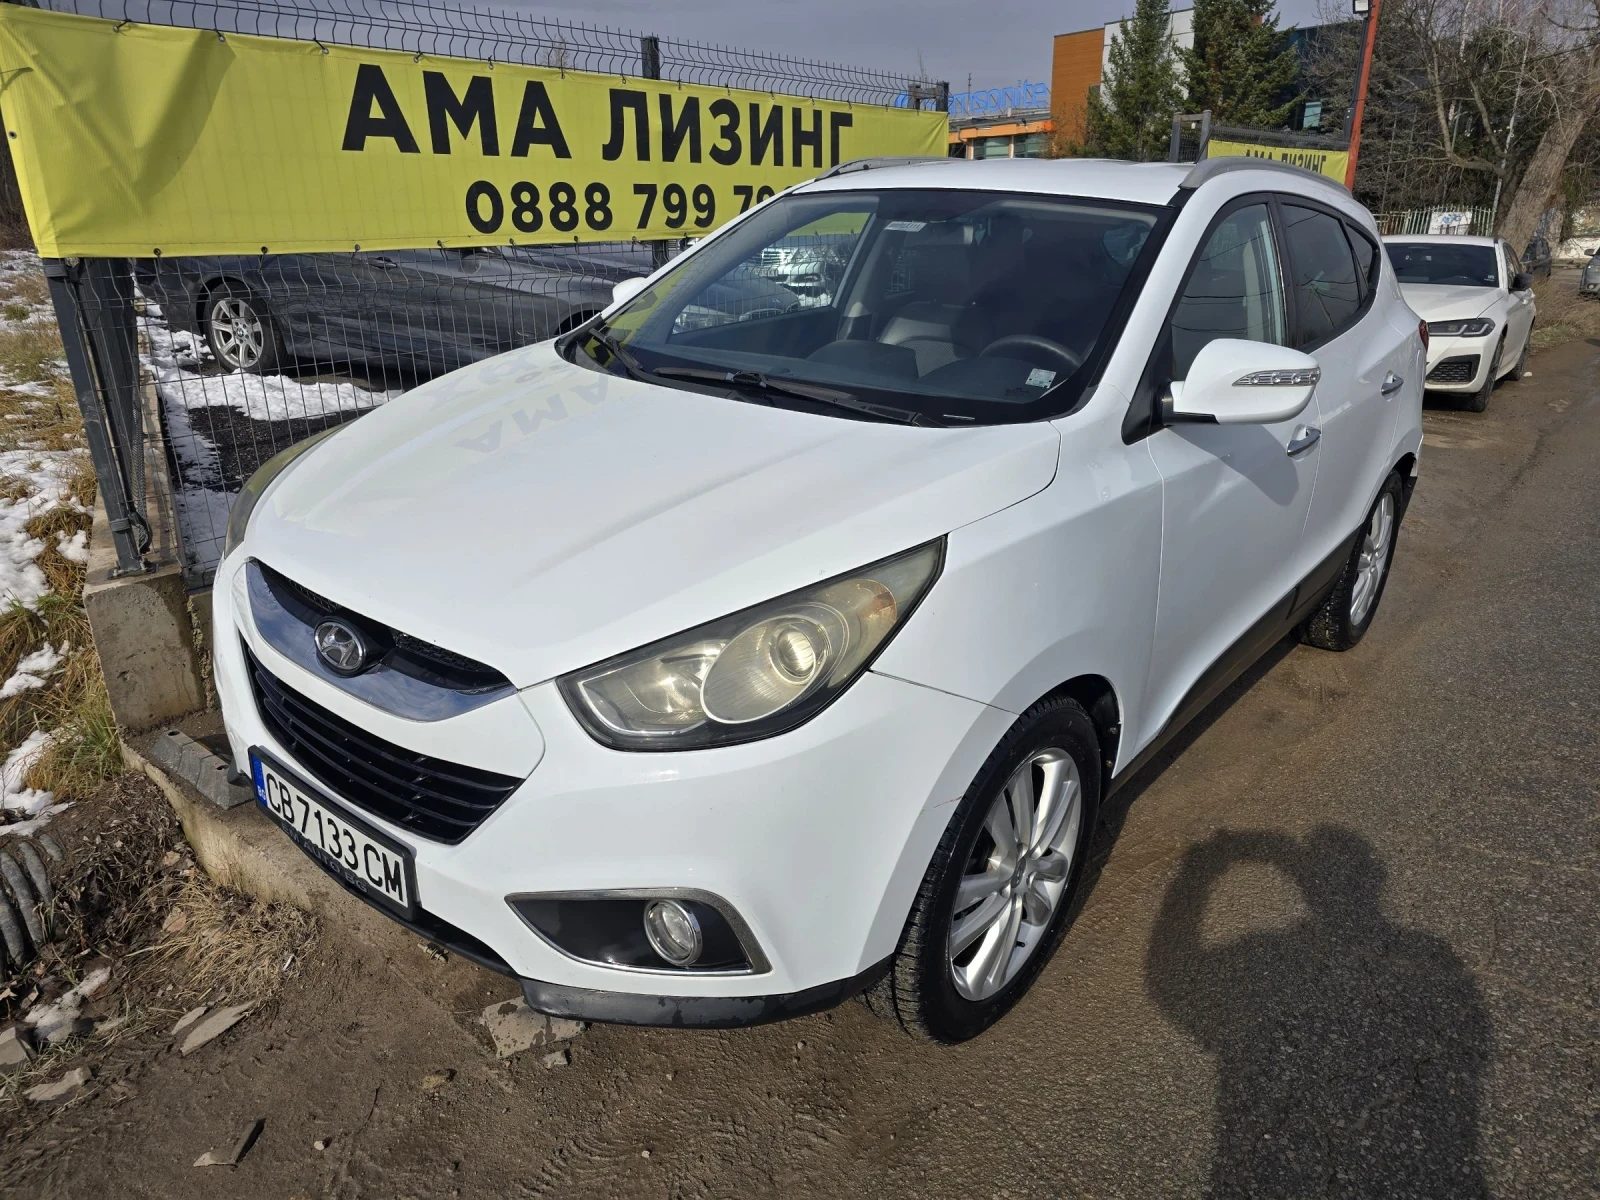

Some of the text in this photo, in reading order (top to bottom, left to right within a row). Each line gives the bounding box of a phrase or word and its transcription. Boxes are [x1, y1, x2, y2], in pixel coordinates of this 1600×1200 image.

[342, 64, 854, 170] АМА ЛИЗИНГ
[466, 179, 613, 235] 0888
[634, 183, 716, 230] 799
[257, 785, 267, 801] BG
